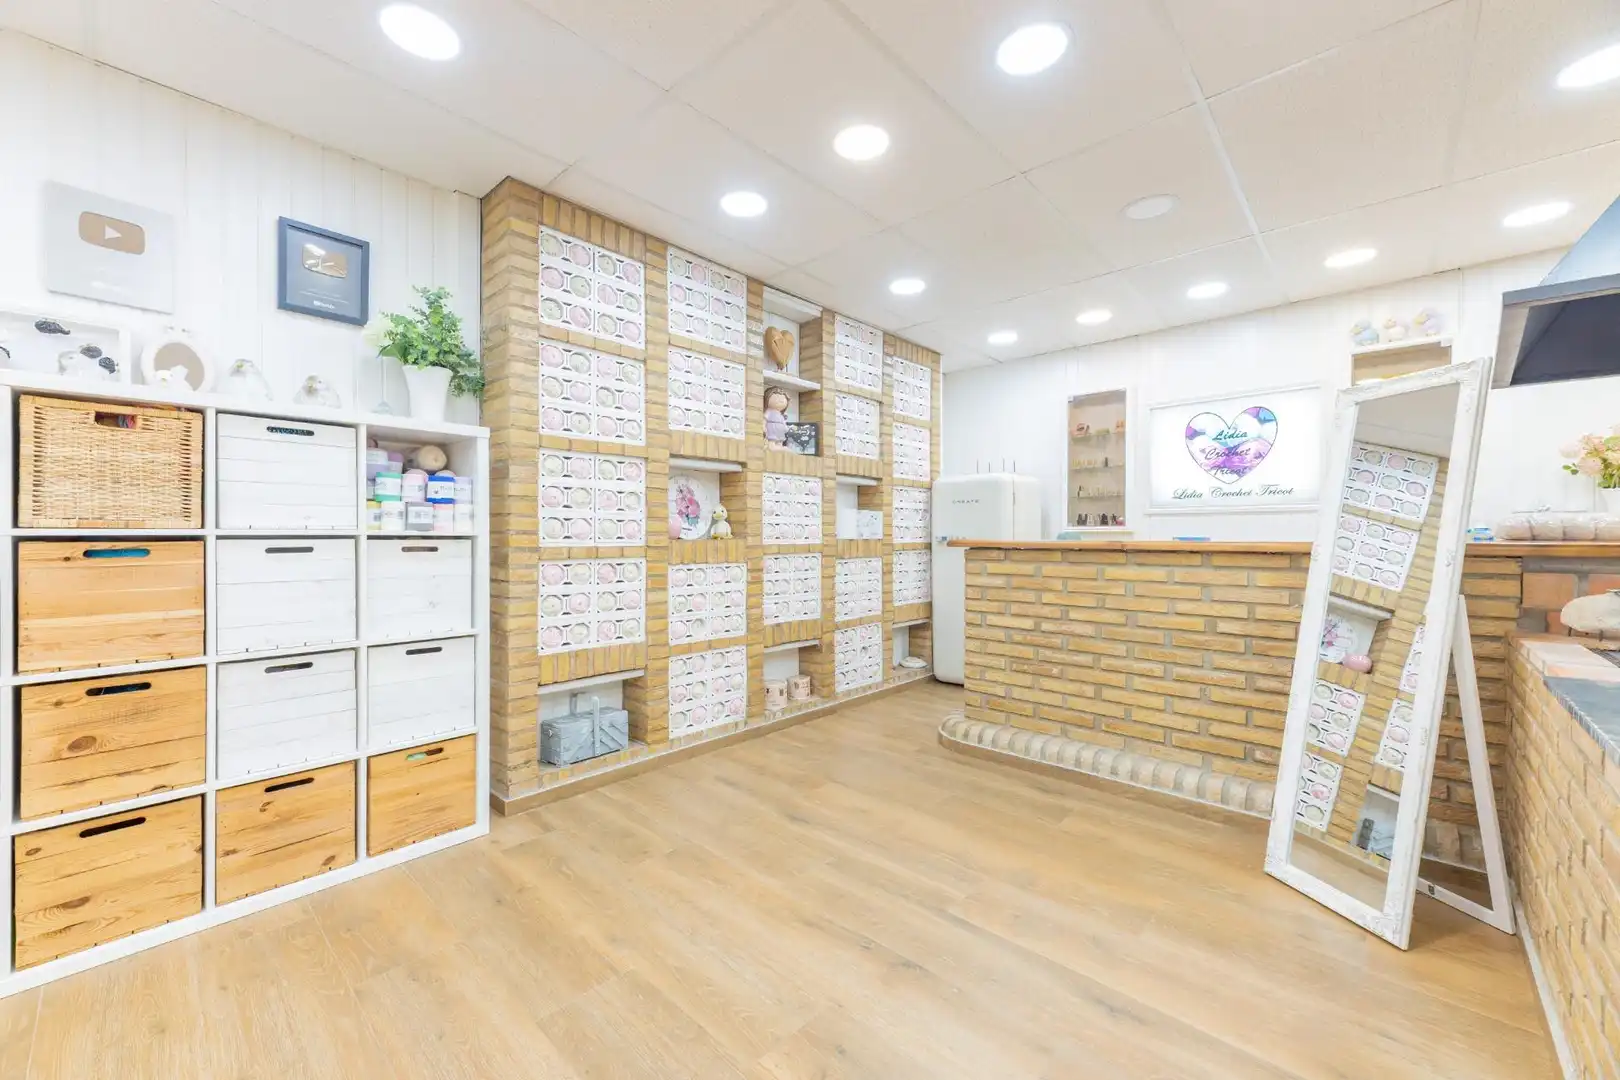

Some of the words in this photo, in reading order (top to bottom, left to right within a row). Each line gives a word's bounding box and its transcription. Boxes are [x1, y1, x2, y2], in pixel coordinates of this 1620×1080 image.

[1212, 430, 1248, 441] Lidia
[1205, 447, 1251, 460] Crochet
[1210, 466, 1248, 476] Tricot
[1172, 488, 1204, 500] Lidia
[1209, 486, 1253, 498] Crochet
[1256, 484, 1295, 496] Tricot
